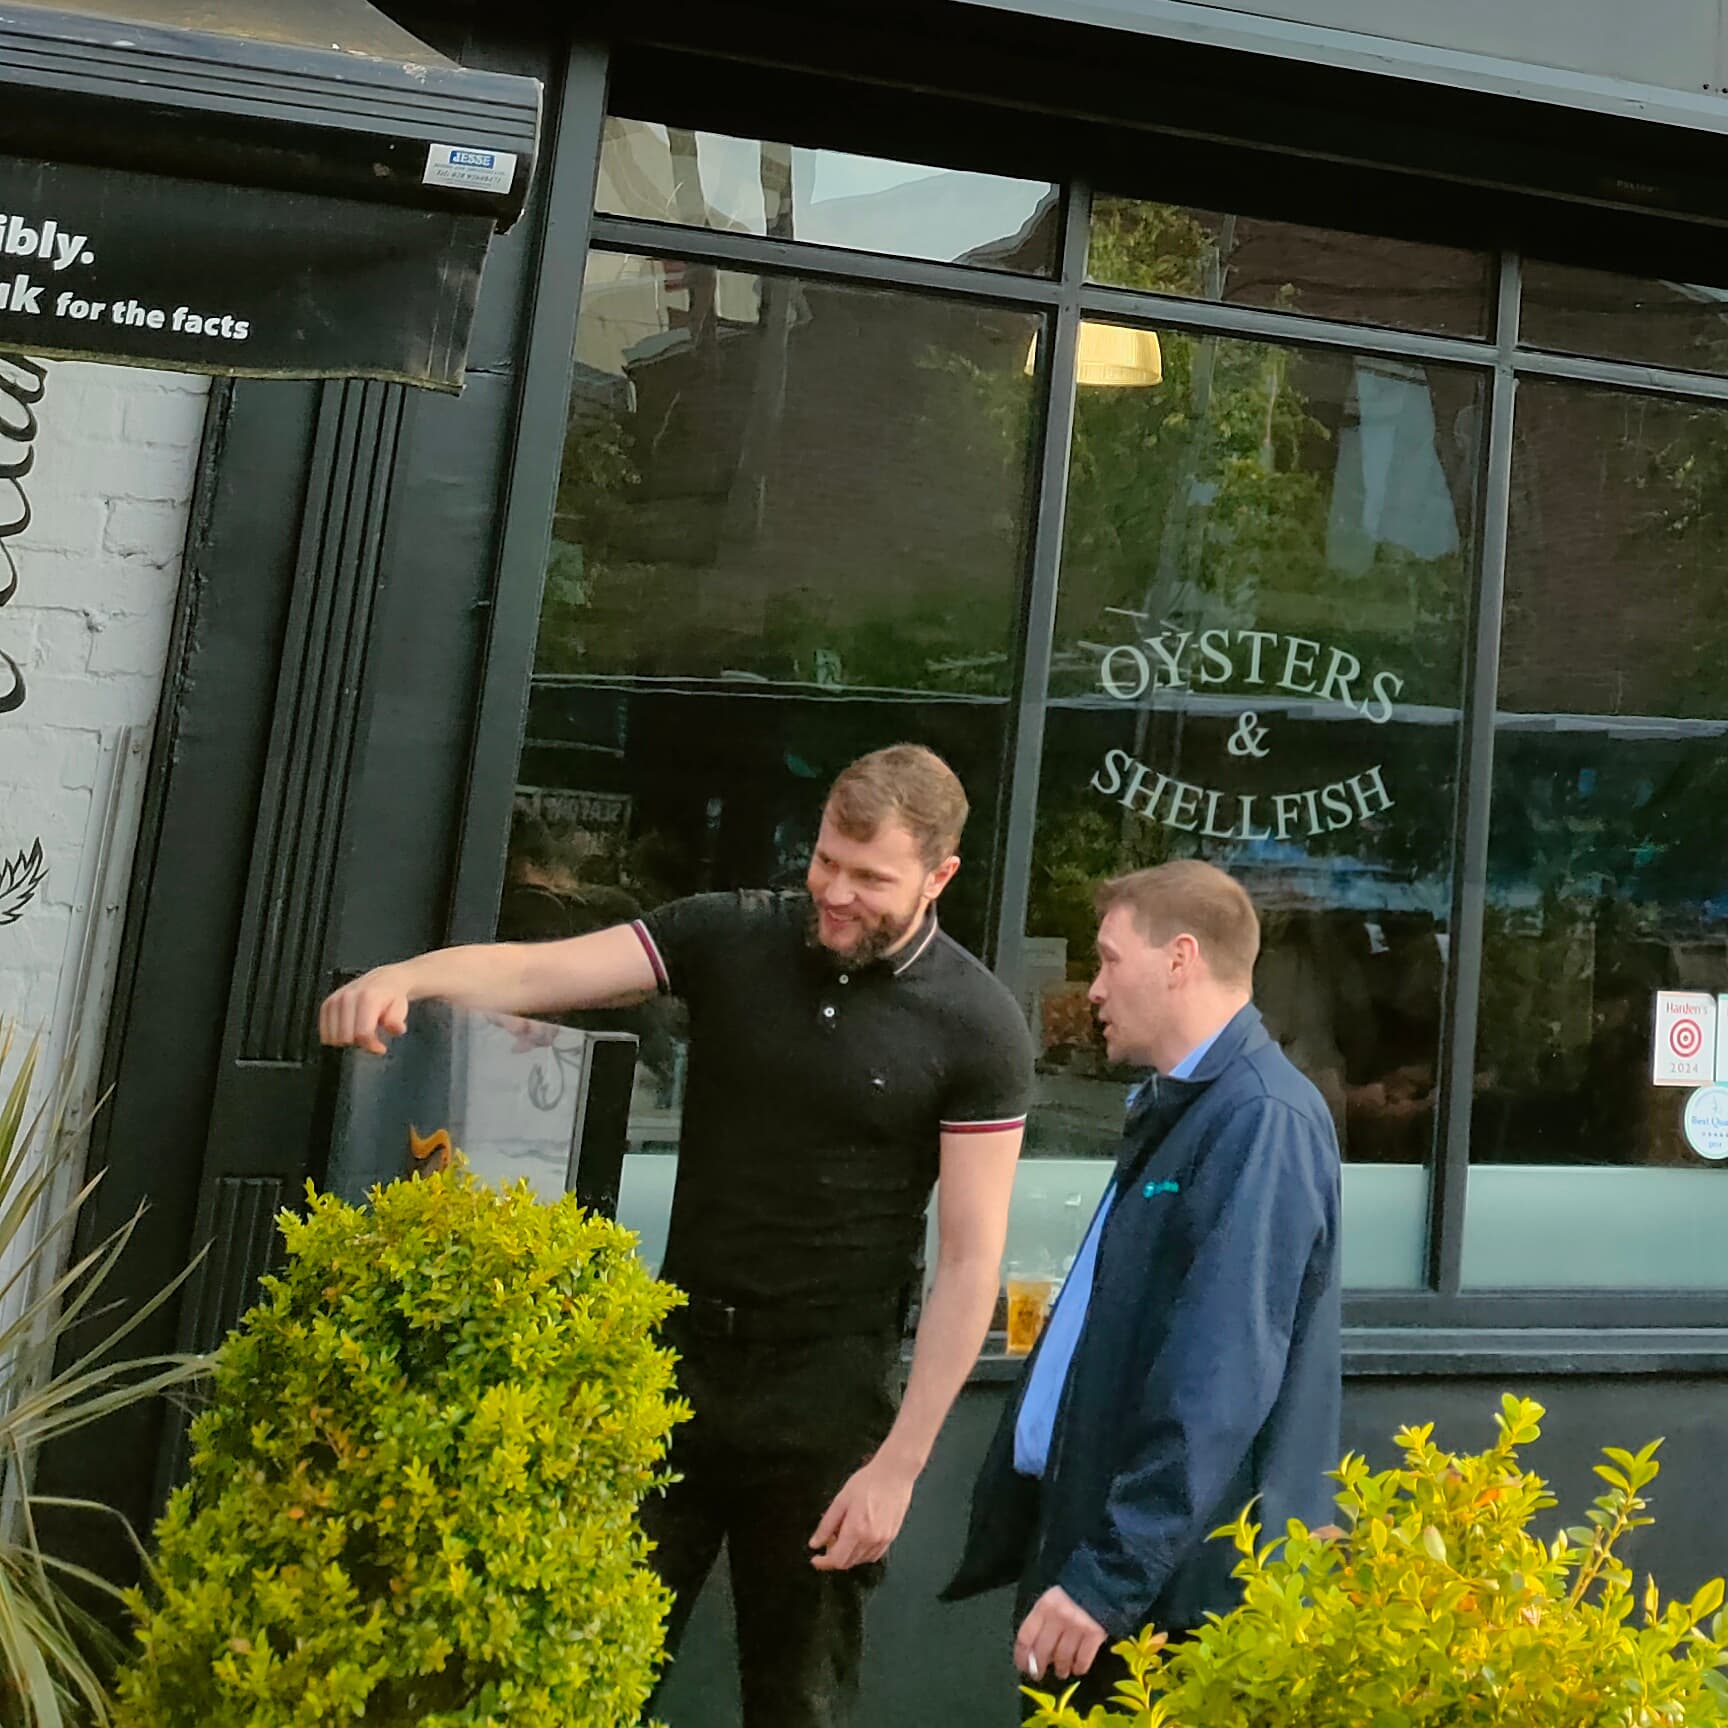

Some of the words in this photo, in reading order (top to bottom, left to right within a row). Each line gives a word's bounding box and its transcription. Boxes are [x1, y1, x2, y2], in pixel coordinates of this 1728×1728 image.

[55, 292, 106, 320] for
[112, 300, 165, 328] the
[172, 306, 250, 340] facts
[1101, 629, 1404, 723] OYSTERS
[1227, 711, 1270, 757] &
[1090, 749, 1395, 841] SHELLFISH
[1666, 1001, 1708, 1015] Harden's
[1670, 1062, 1698, 1073] 2024
